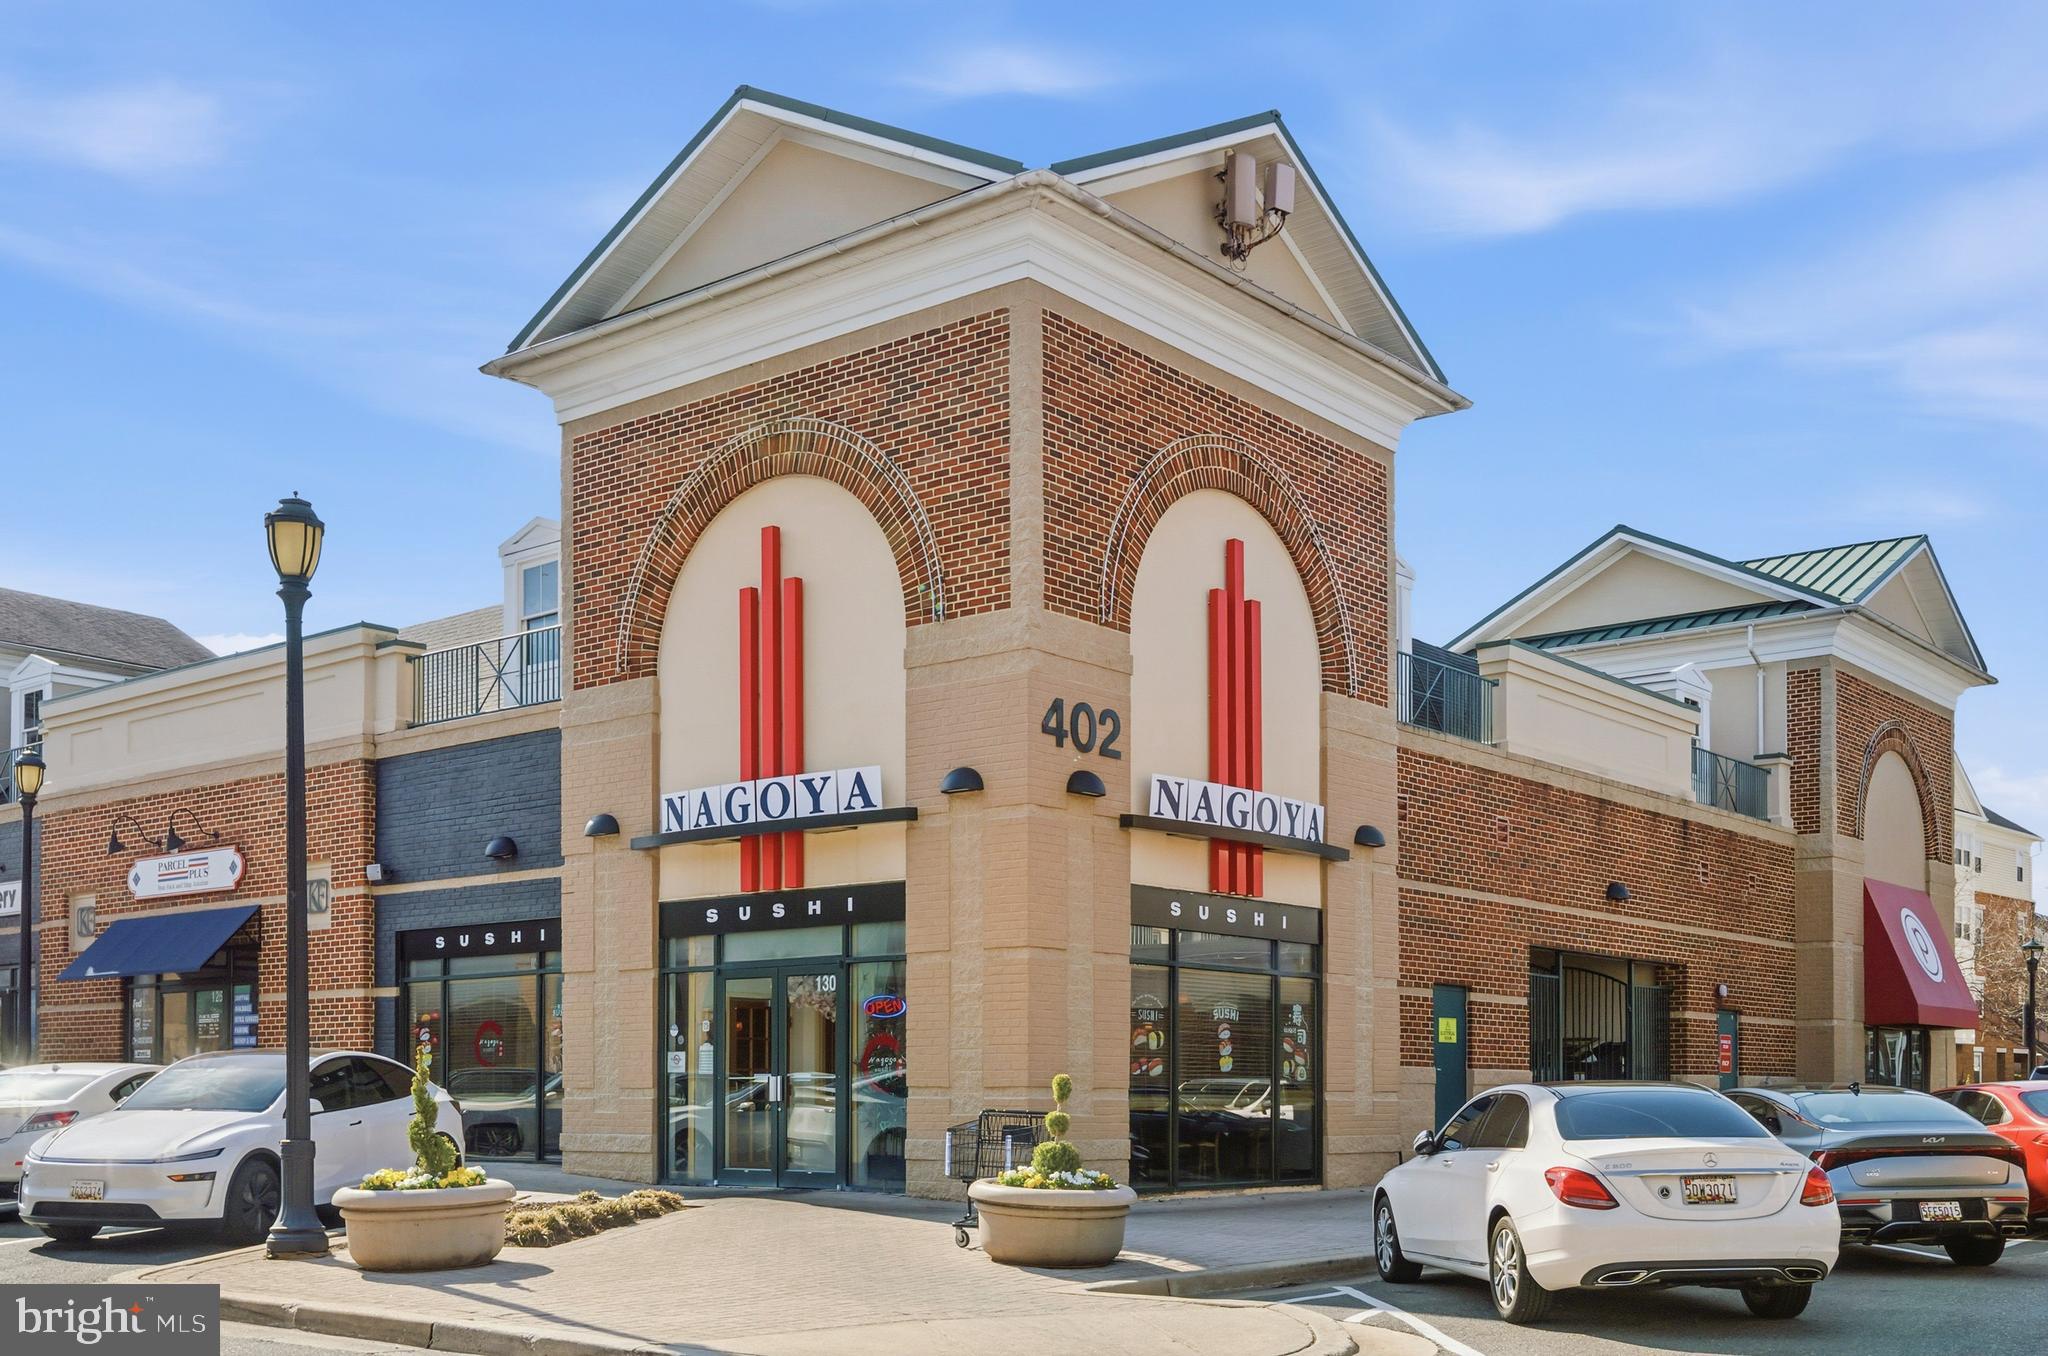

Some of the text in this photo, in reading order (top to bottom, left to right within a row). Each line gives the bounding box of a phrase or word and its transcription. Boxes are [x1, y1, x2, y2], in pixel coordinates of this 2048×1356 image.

[1041, 697, 1122, 760] 402
[664, 771, 878, 832] NAGOYA
[1153, 778, 1322, 843] NAGOYA
[158, 859, 187, 872] PARCEL
[189, 868, 209, 879] PLUS
[706, 897, 854, 923] SUSHI
[1170, 901, 1288, 929] SUSHI
[435, 928, 545, 949] SUSHI
[815, 975, 837, 992] 130
[865, 998, 903, 1015] OPEN
[1213, 1008, 1240, 1022] SUSHI
